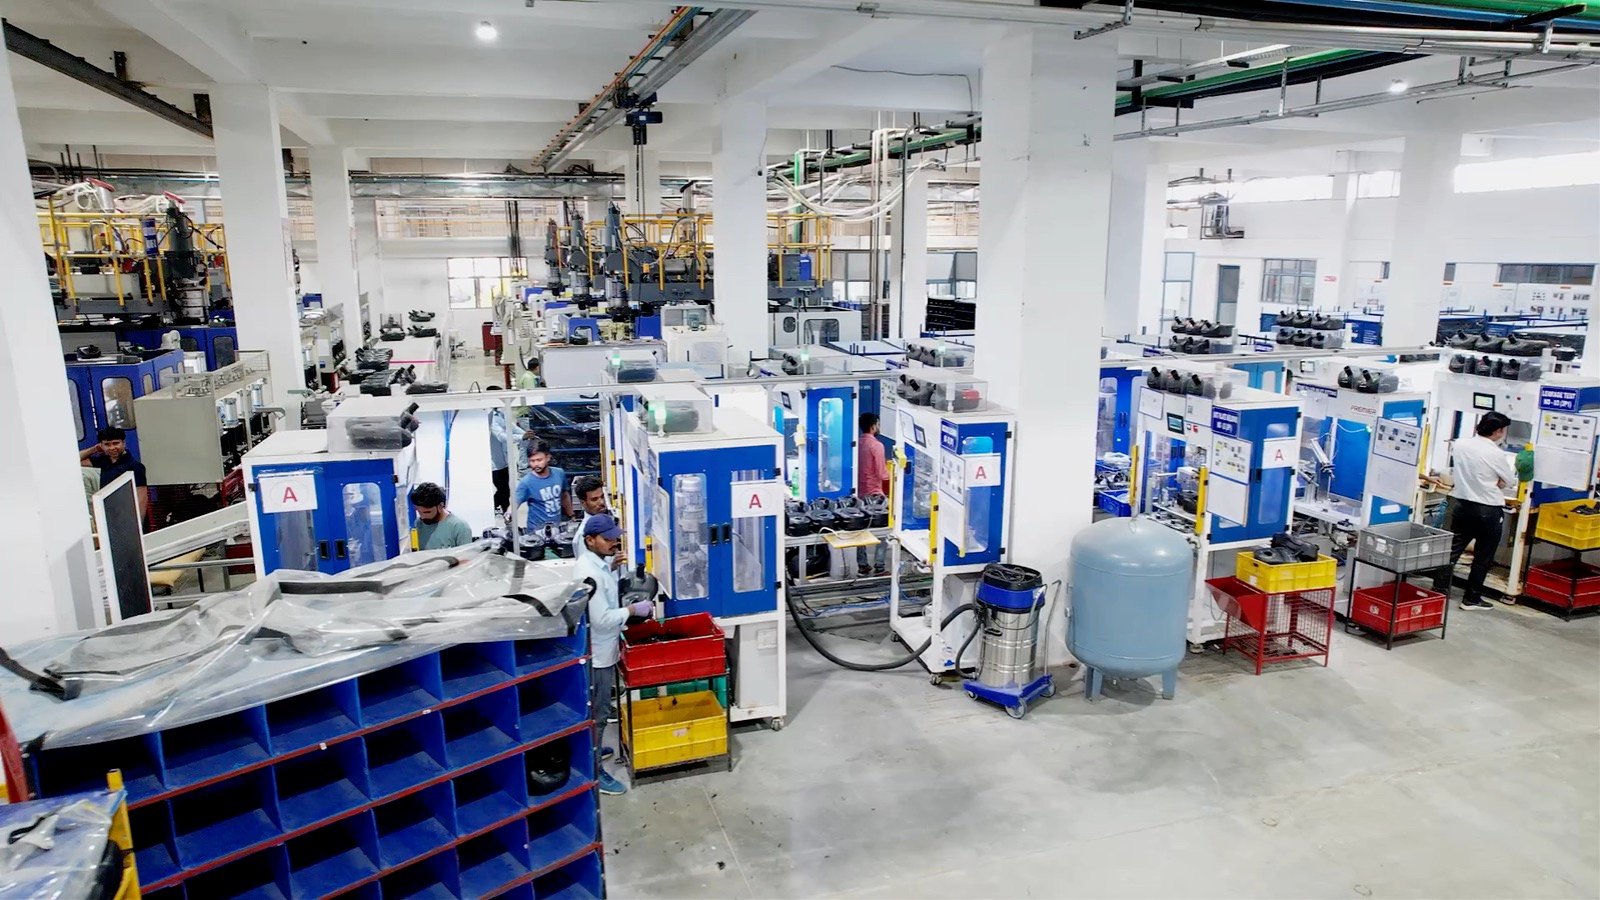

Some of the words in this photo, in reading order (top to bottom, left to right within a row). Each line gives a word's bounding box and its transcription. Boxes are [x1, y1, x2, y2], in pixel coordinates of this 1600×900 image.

[1275, 448, 1284, 461] A
[975, 465, 987, 480] A
[282, 486, 298, 503] A
[540, 484, 561, 501] MO
[749, 494, 762, 509] A
